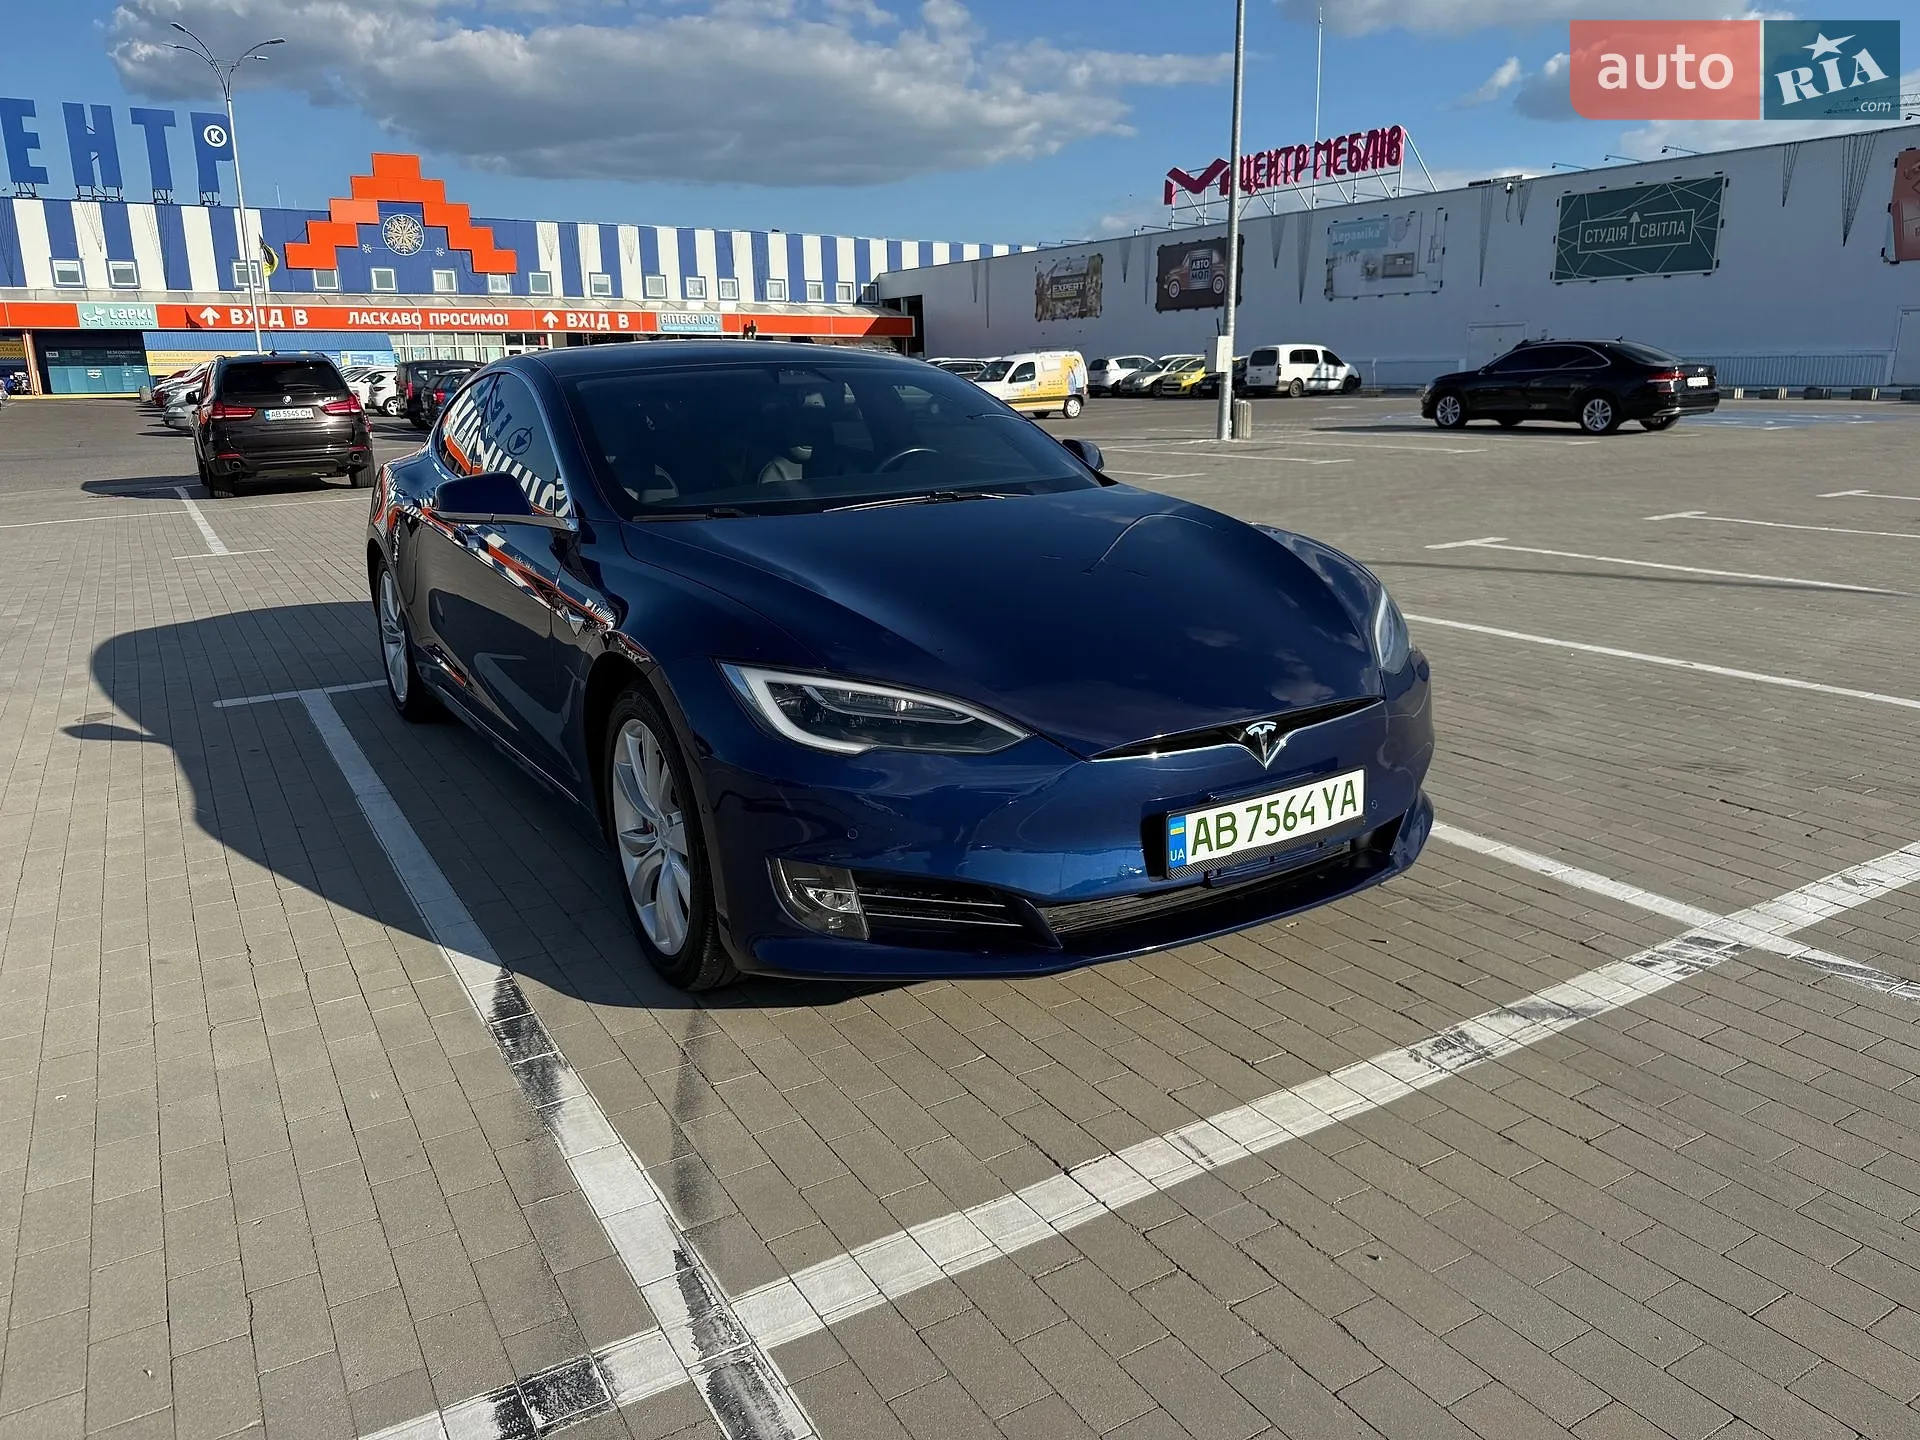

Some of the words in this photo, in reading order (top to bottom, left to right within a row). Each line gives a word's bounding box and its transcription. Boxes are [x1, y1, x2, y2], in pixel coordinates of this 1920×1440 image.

[1240, 143, 1310, 195] ЦЕНТР
[1313, 124, 1405, 180] МЕБЛІВ
[1584, 225, 1628, 244] СТУДІЯ
[1639, 220, 1686, 238] СВІТЛА
[1191, 259, 1209, 270] АВТО
[1052, 282, 1084, 292] EXPERT
[294, 309, 309, 326] В
[347, 311, 422, 326] ЛАСКАВО
[429, 312, 509, 326] ПРОСИМО!
[566, 312, 610, 330] ВХІД
[618, 313, 630, 328] В
[661, 313, 698, 325] АПТЕКА
[1191, 811, 1238, 857] AB
[1245, 790, 1315, 844] 7564
[1322, 779, 1357, 822] YA
[1170, 849, 1185, 863] UA
